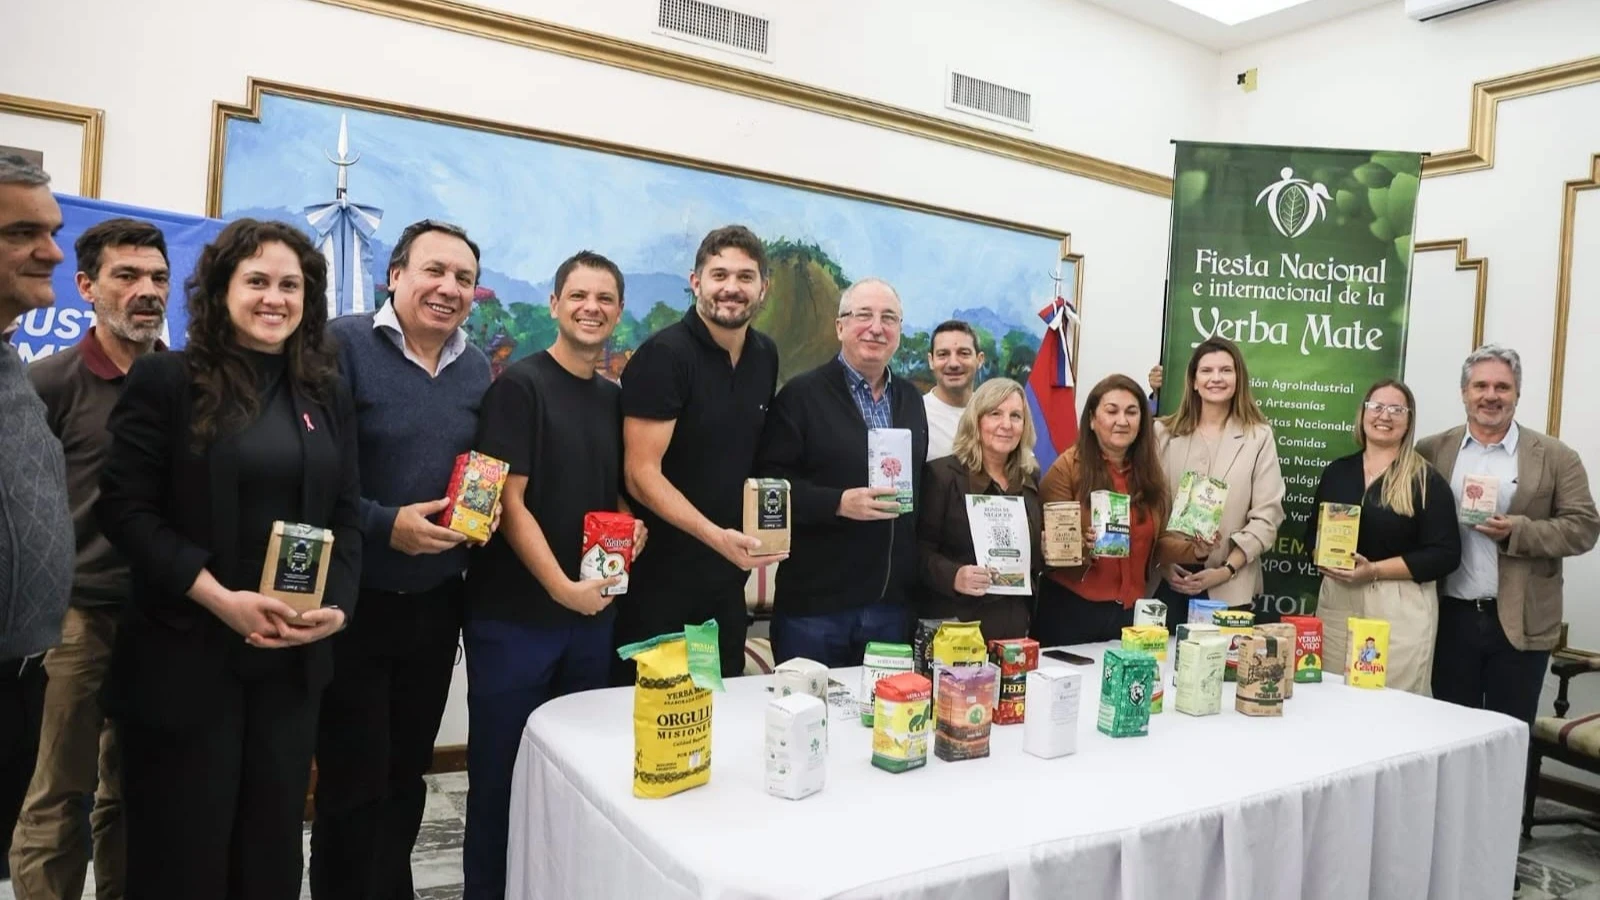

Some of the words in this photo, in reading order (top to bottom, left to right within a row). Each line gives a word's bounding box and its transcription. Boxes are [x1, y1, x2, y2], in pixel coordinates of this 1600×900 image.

[1195, 249, 1269, 278] Fiesta
[1280, 253, 1386, 284] Nacional
[1192, 281, 1201, 296] e
[1209, 279, 1332, 303] internacional
[1338, 287, 1360, 306] de
[1368, 287, 1385, 307] la
[1191, 307, 1288, 349] Yerba
[1300, 314, 1384, 355] Mate
[1249, 378, 1268, 388] ión
[1272, 379, 1354, 394] AgroIndustrial
[1266, 398, 1326, 411] Artesanías
[1279, 436, 1327, 449] Comidas
[1291, 511, 1312, 522] Yer
[667, 689, 693, 700] YERBA
[656, 703, 712, 726] ORGULL
